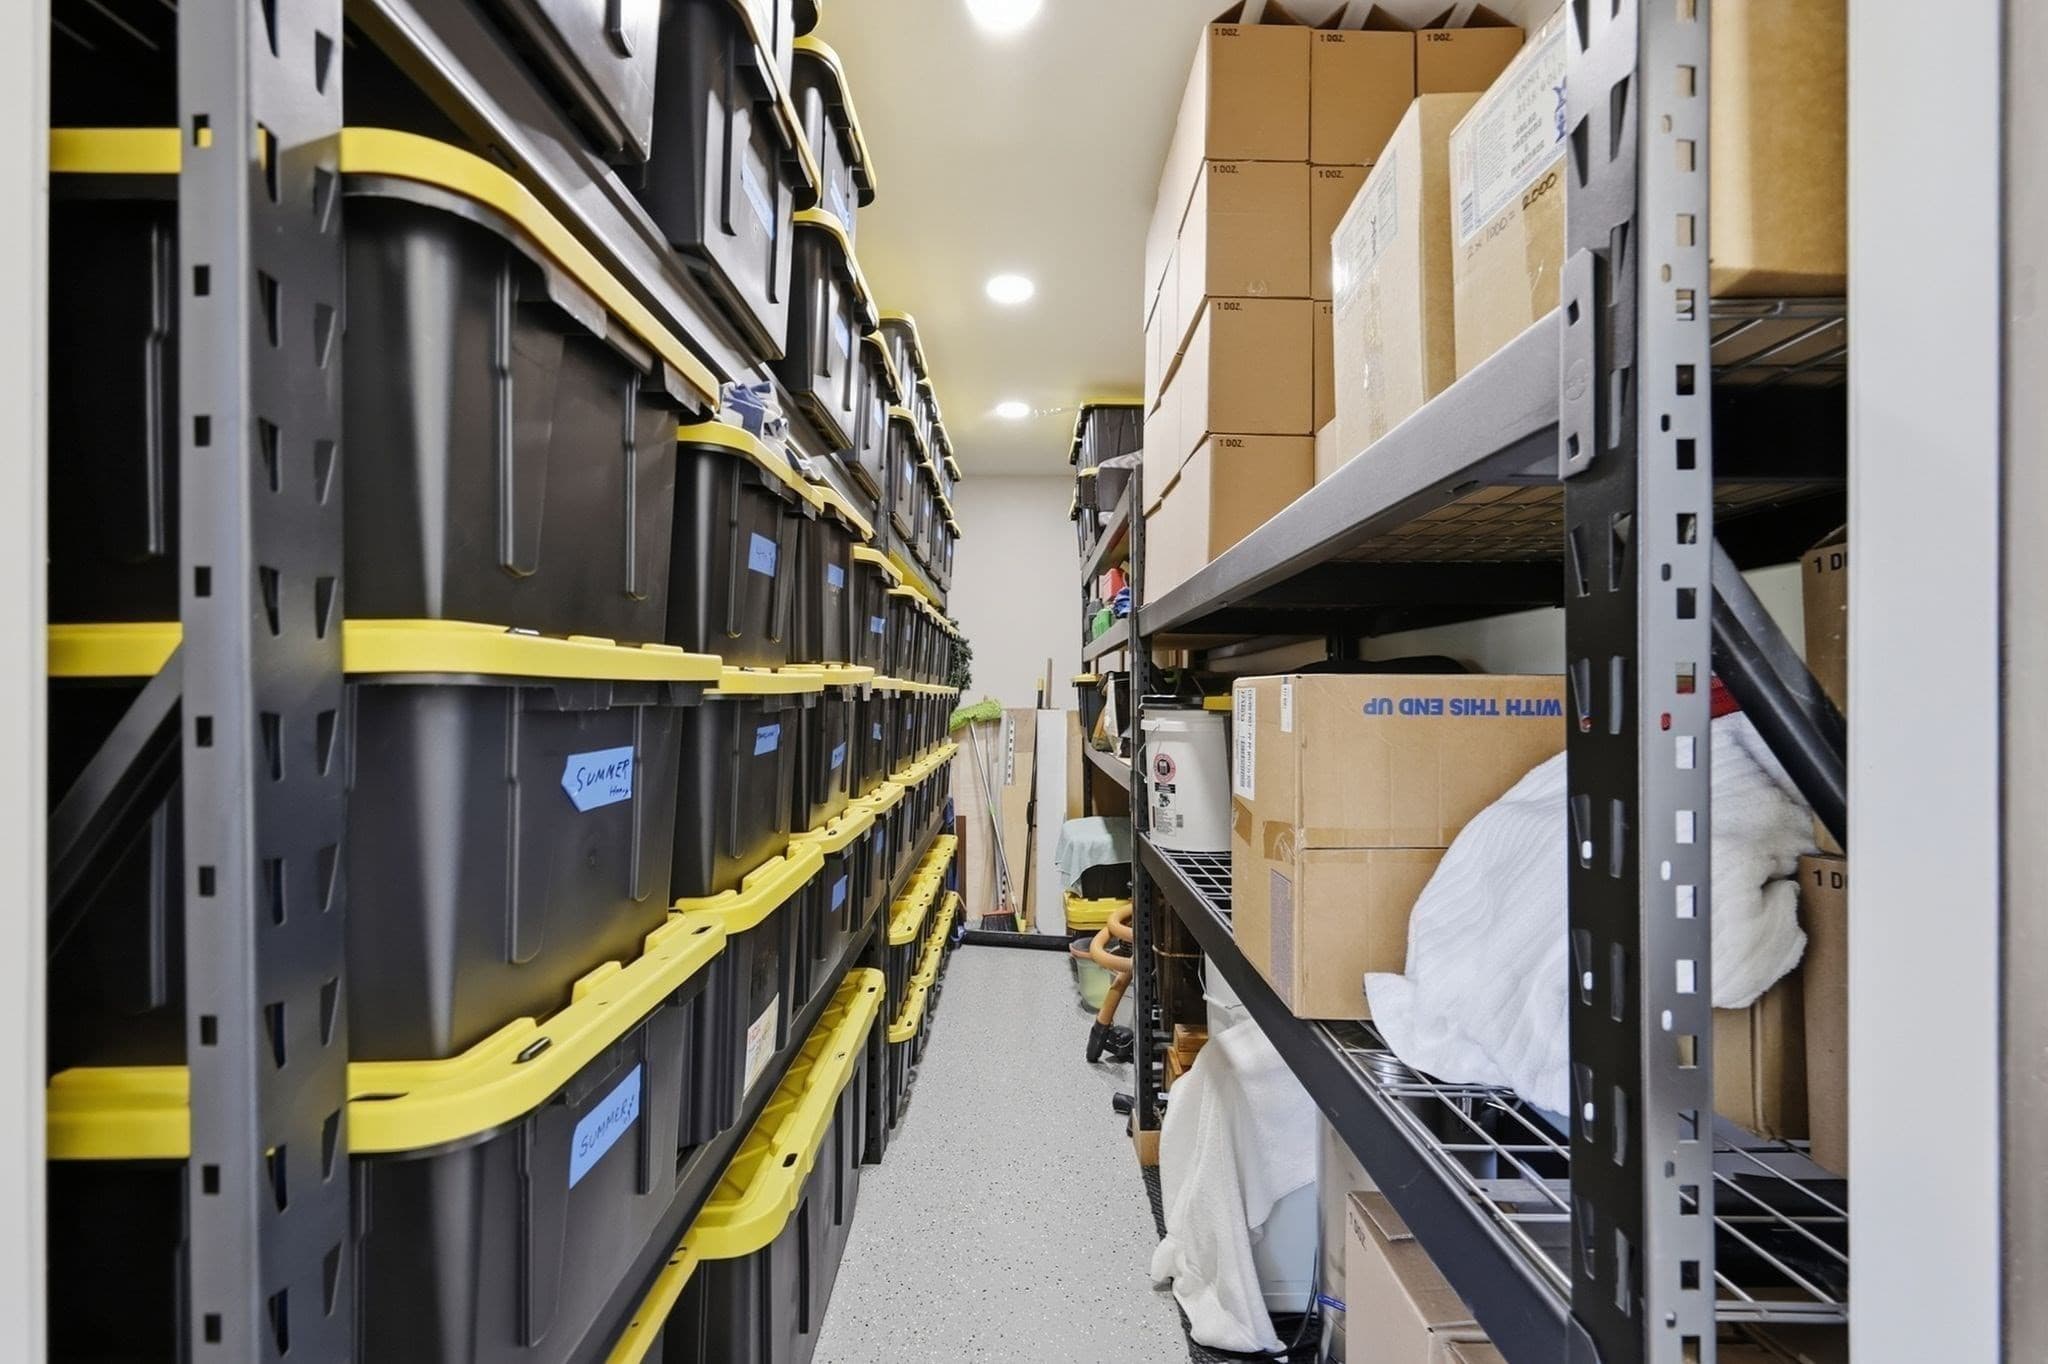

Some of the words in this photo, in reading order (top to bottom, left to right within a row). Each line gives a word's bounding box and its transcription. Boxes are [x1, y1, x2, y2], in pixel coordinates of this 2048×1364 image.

[1221, 28, 1240, 37] DOZ.
[1326, 34, 1345, 43] DOZ.
[1433, 33, 1453, 42] DOZ.
[1219, 165, 1239, 174] DOZ.
[1325, 170, 1344, 179] DOZ.
[1223, 302, 1242, 311] DOZ.
[1225, 439, 1245, 448] DOZ.
[1813, 556, 1822, 573] 1
[1363, 697, 1393, 715] UP
[1399, 697, 1444, 715] END
[1449, 698, 1499, 716] THIS
[1505, 698, 1563, 716] WITH
[576, 758, 631, 792] SUMMER
[1812, 869, 1822, 887] 1
[1830, 871, 1848, 889] D
